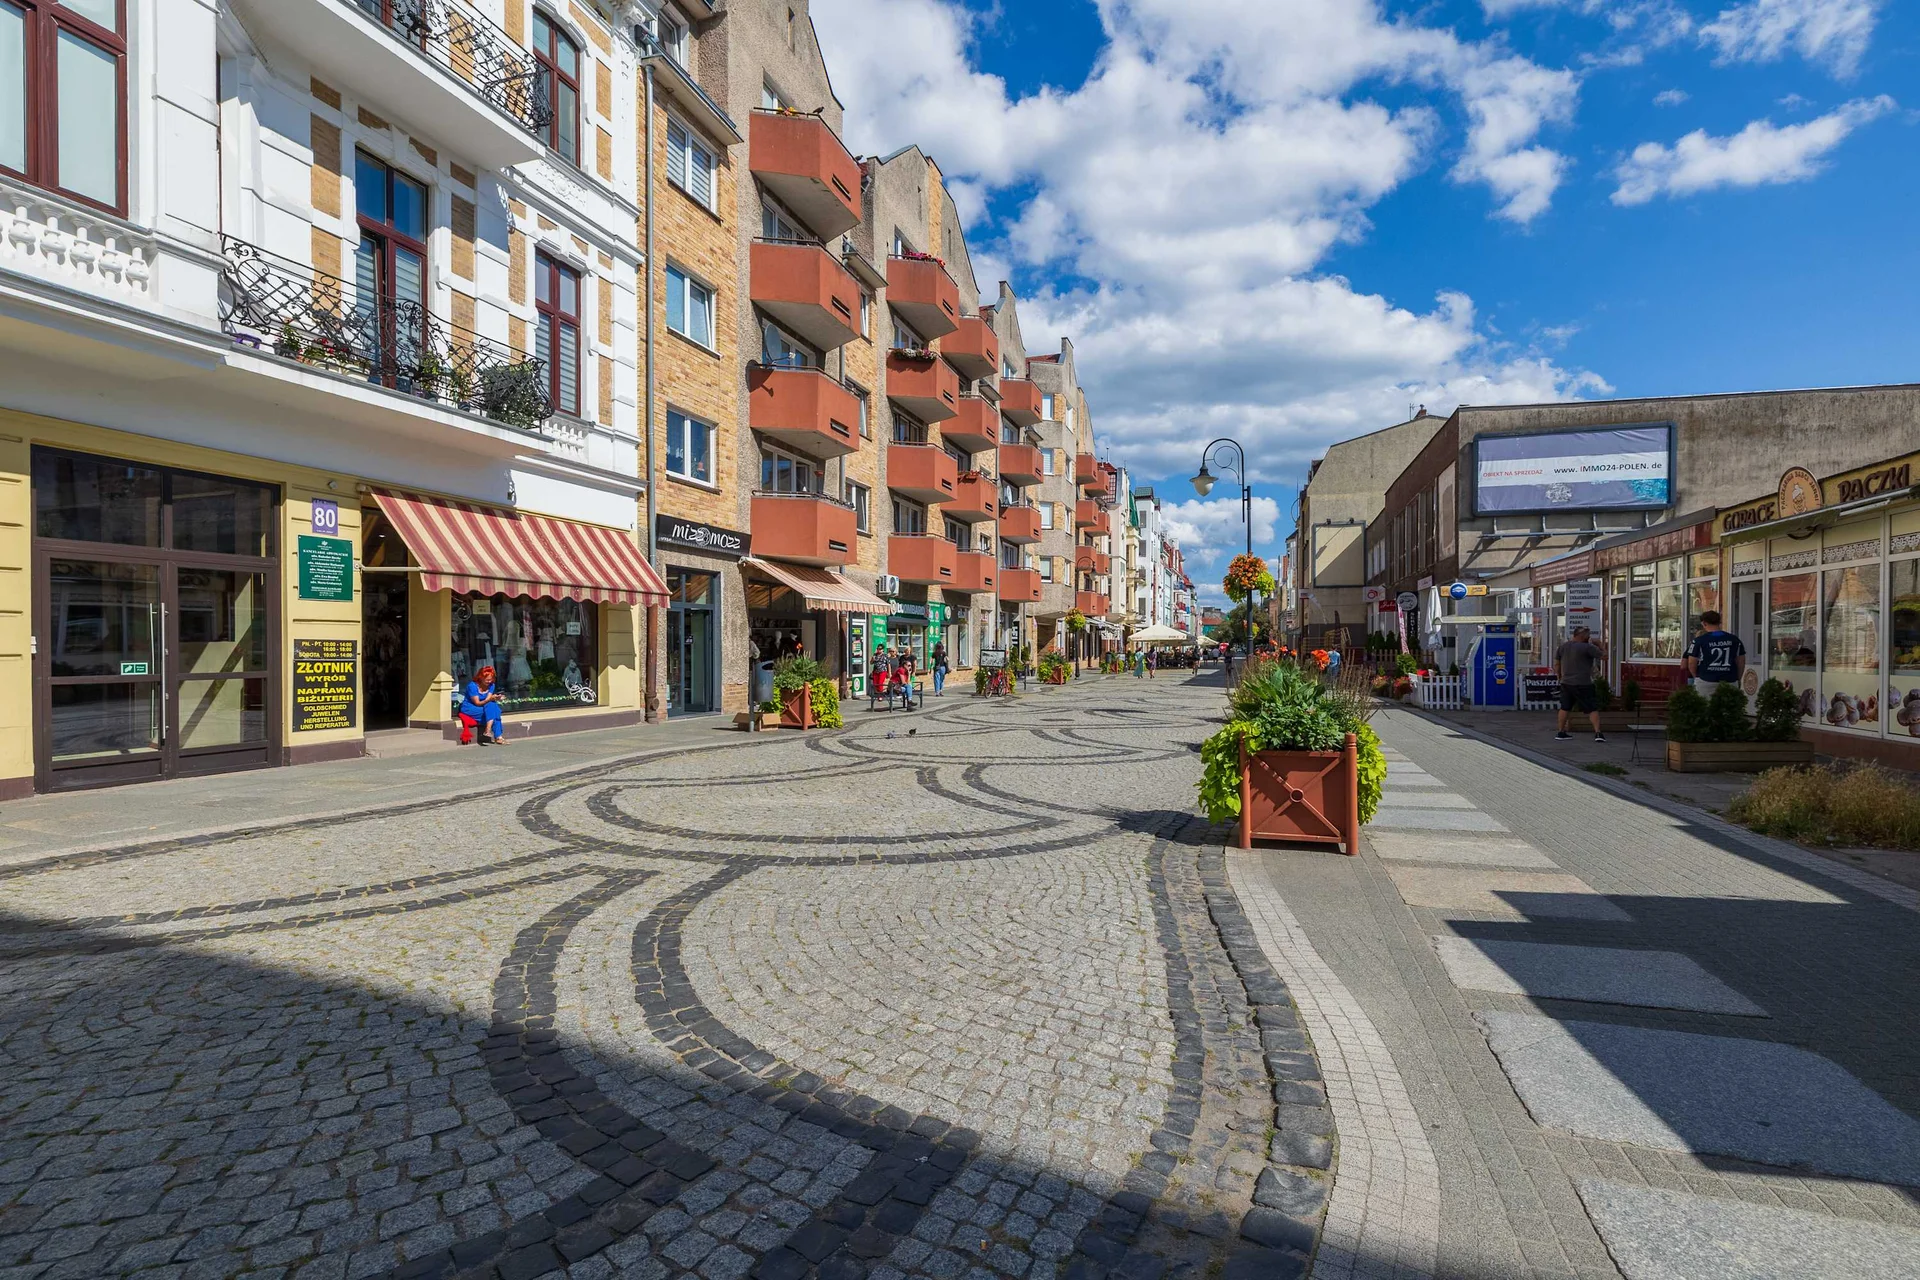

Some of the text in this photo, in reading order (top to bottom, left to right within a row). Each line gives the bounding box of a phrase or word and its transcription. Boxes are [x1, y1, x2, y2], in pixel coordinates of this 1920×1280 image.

[1651, 462, 1662, 470] de
[314, 507, 336, 528] 80
[1709, 647, 1731, 666] 21
[296, 662, 354, 674] ZŁOTNIK
[304, 674, 346, 682] WYRÓB
[297, 687, 353, 695] NAPRAWA
[297, 694, 353, 703] BIŻUTERII
[303, 716, 347, 724] HERSTELLUNG
